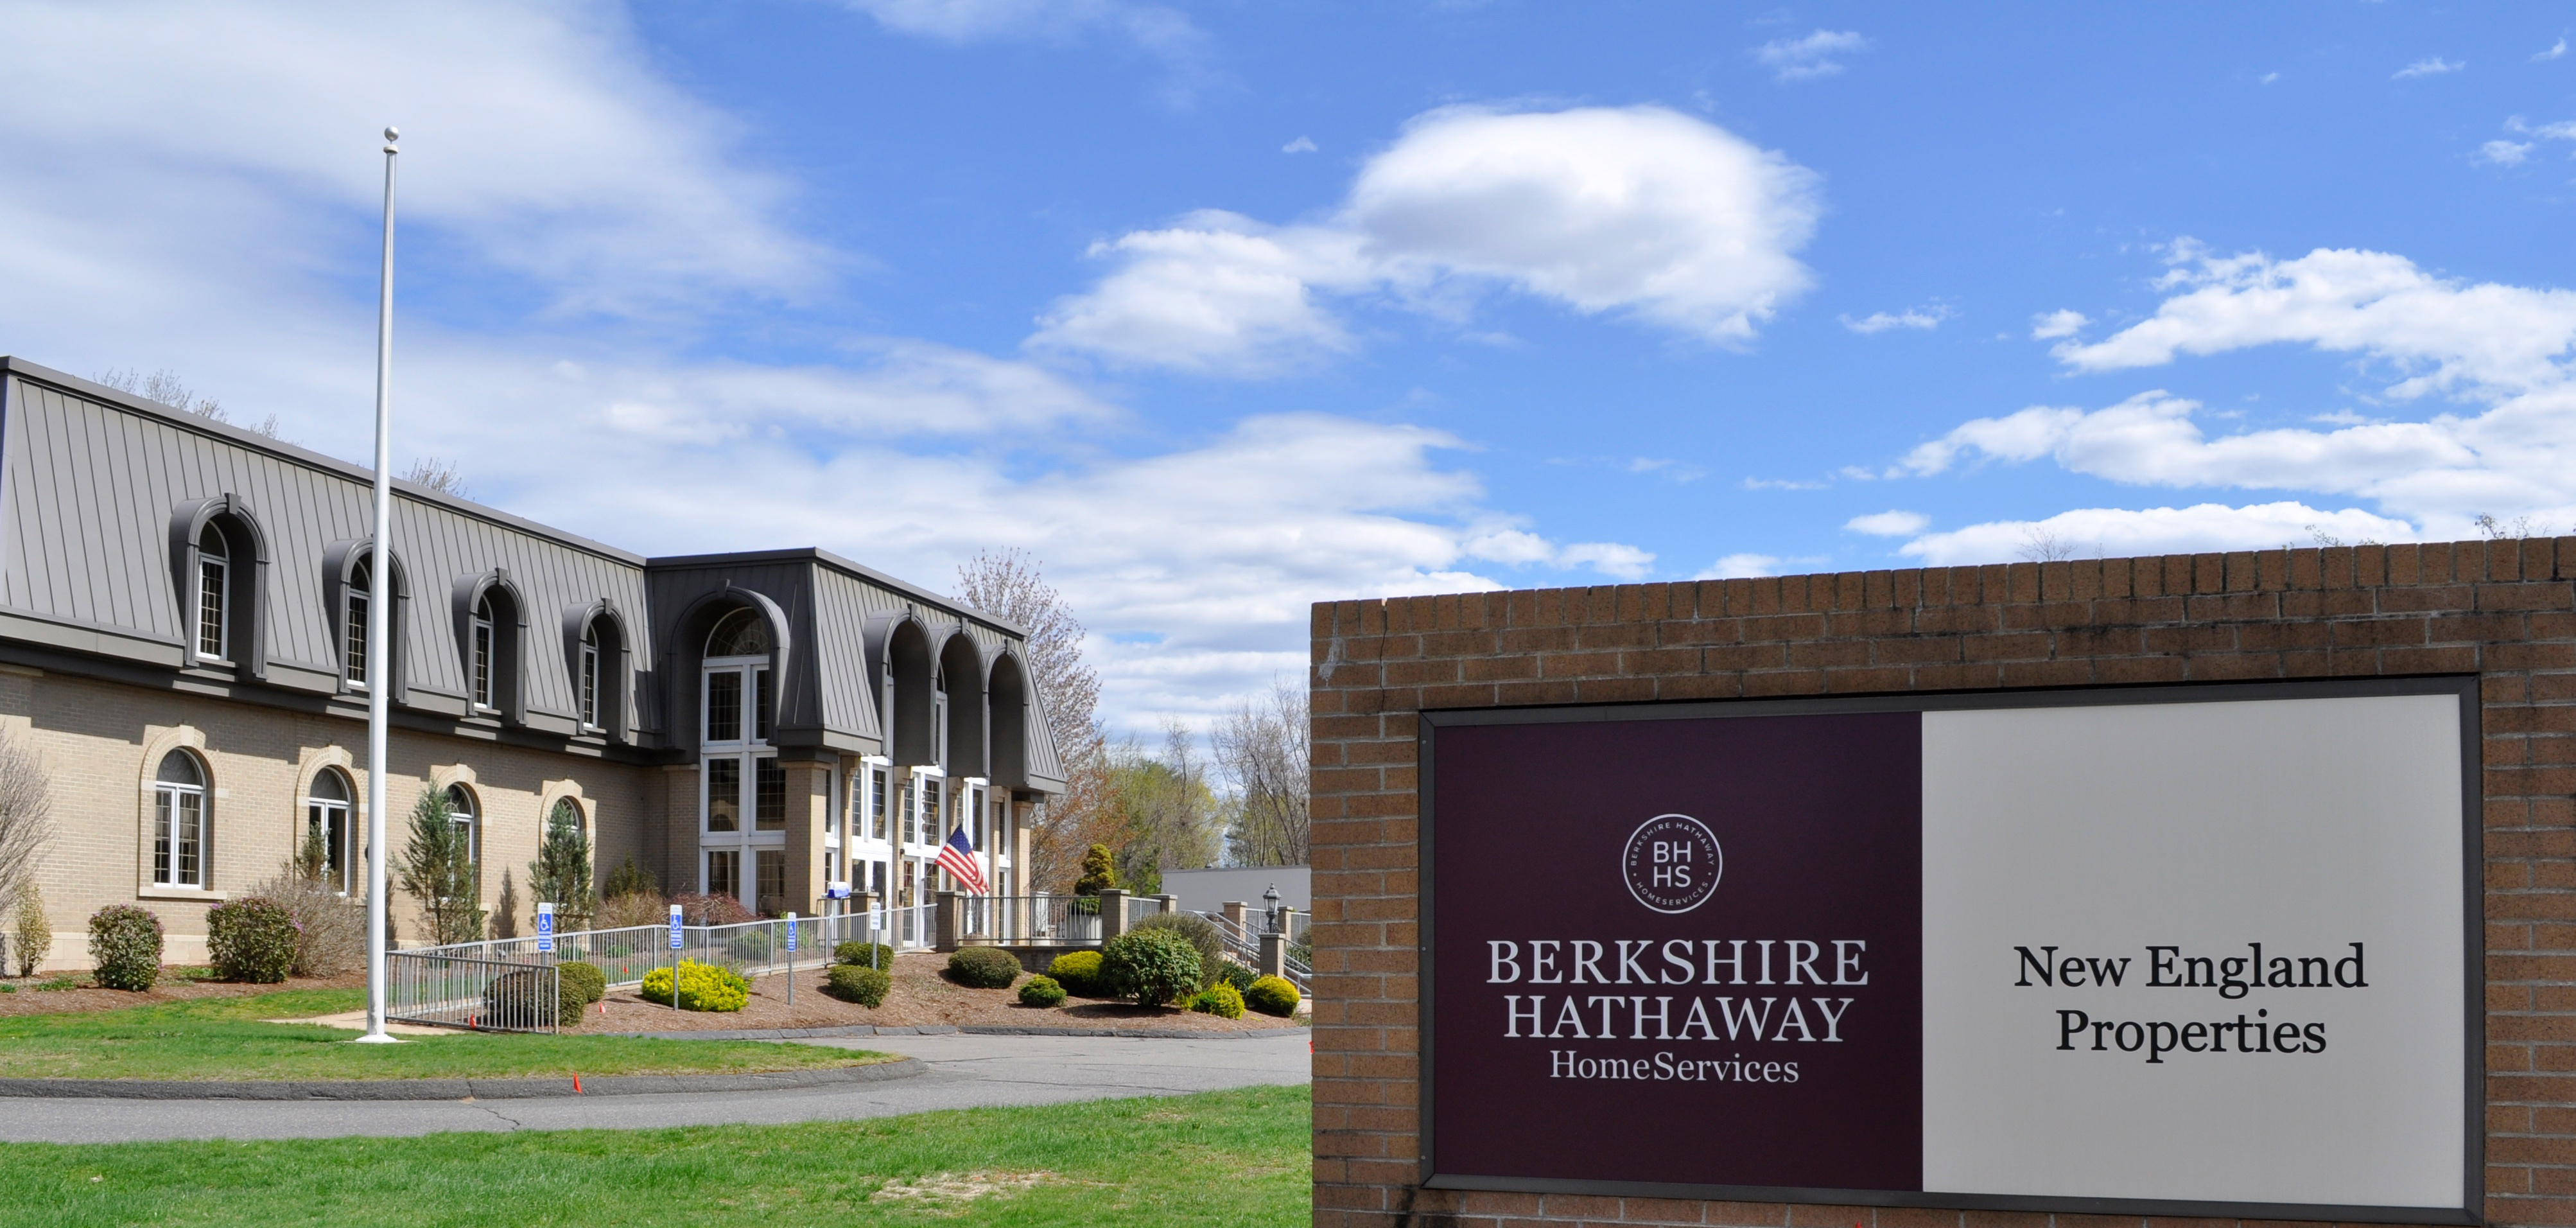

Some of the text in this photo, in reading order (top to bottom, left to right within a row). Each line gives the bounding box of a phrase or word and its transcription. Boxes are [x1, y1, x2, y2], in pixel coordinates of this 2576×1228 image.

[1653, 841, 1691, 863] BH
[1653, 865, 1691, 888] HS
[1486, 939, 1868, 985] BERKSHIRE
[2014, 942, 2369, 999] New England
[1504, 995, 1854, 1042] HATHAWAY
[2055, 1008, 2326, 1064] Properties
[1550, 1050, 1799, 1083] HomeServices
